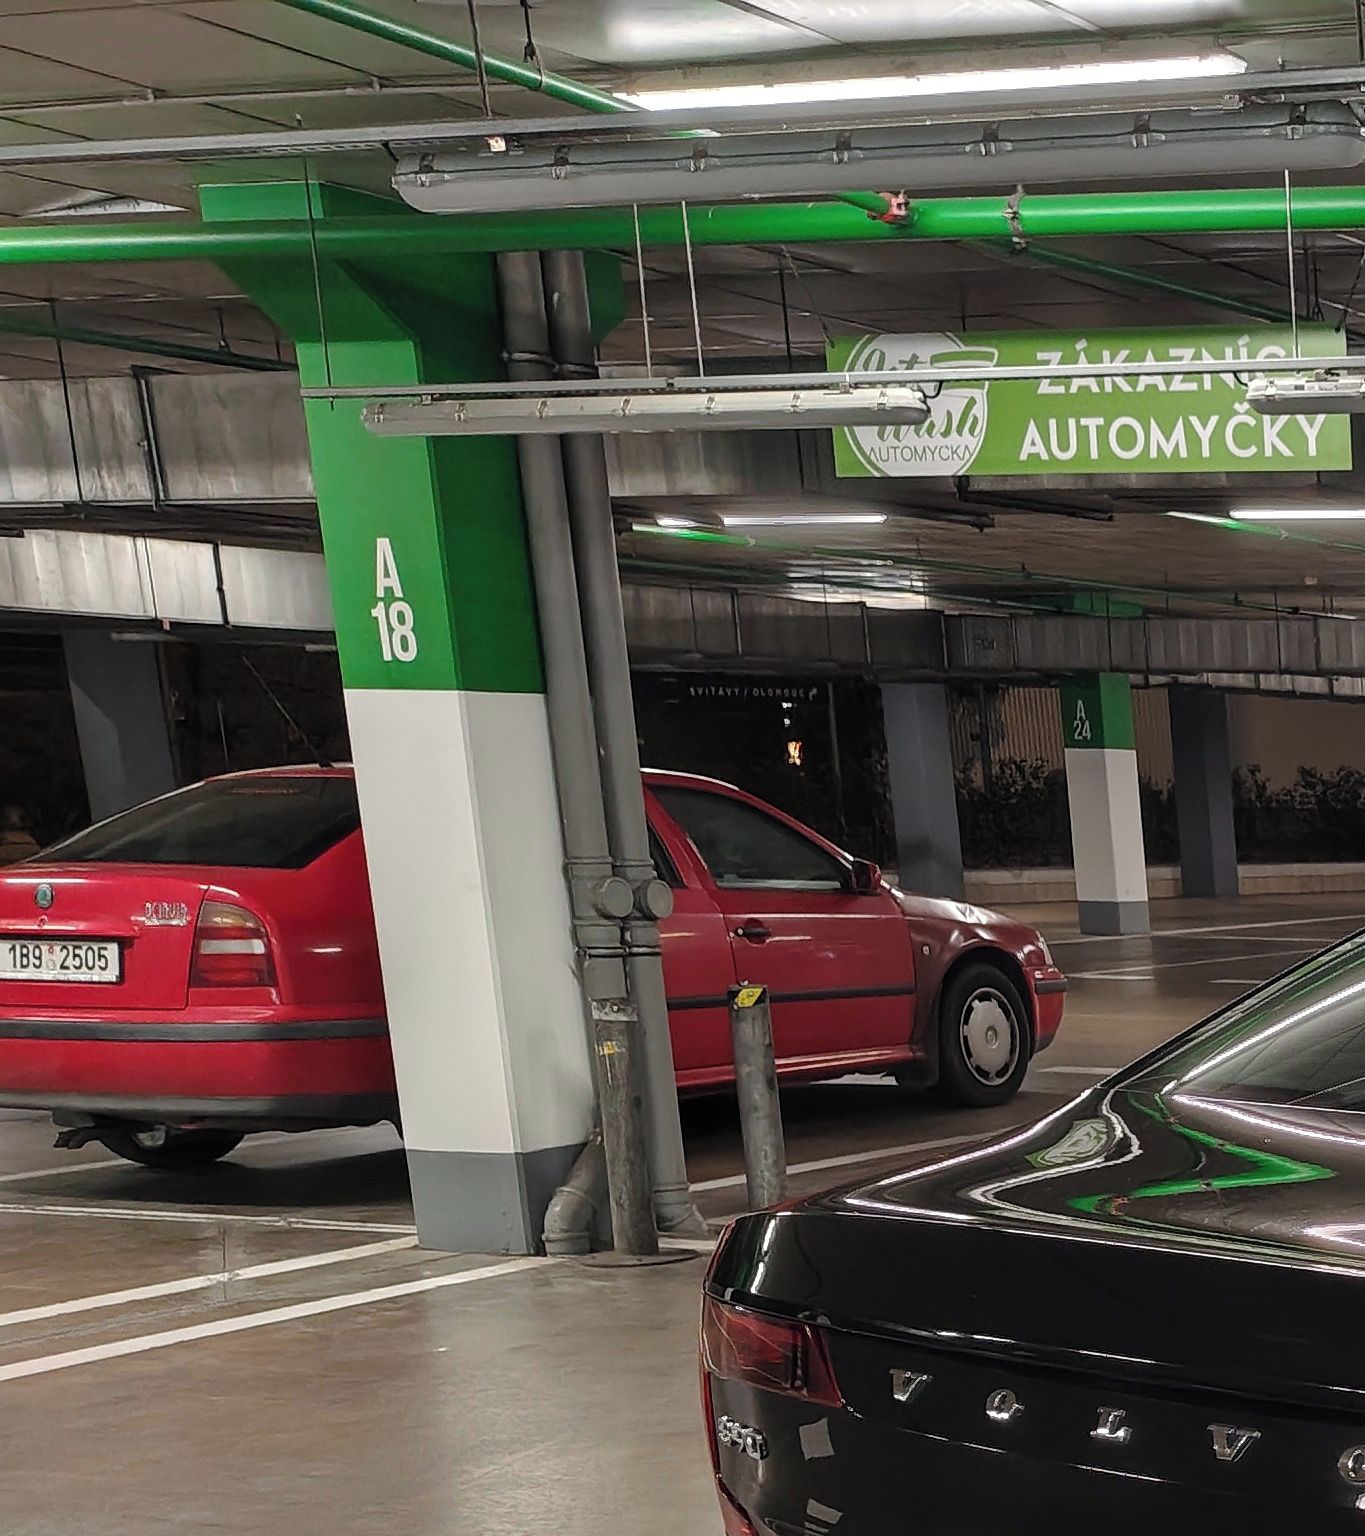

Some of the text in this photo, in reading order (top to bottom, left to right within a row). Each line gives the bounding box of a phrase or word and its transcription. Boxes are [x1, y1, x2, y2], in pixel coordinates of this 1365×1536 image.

[876, 396, 980, 442] ash
[1018, 401, 1328, 461] AUTOMYČKY
[376, 537, 404, 598] A
[370, 601, 418, 662] 18
[1073, 720, 1091, 740] 24
[1076, 700, 1086, 720] A
[9, 944, 109, 971] 1B9 2505
